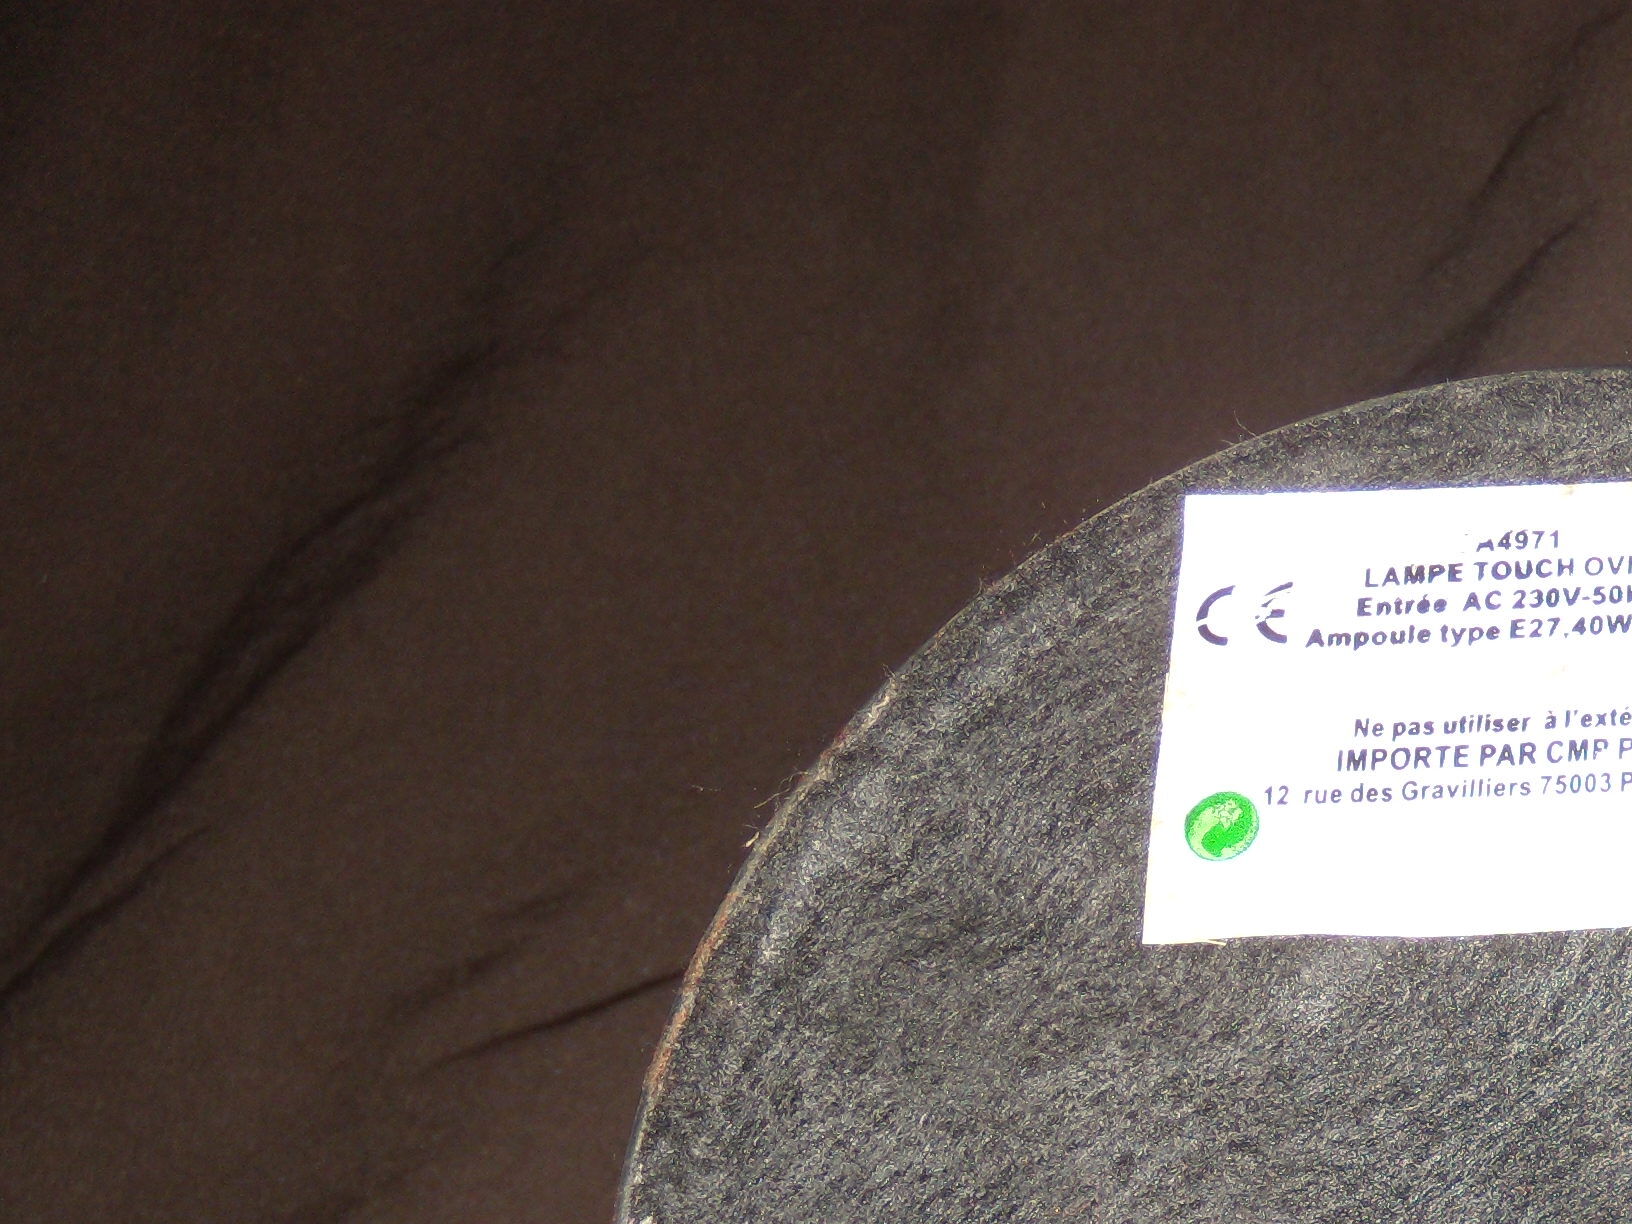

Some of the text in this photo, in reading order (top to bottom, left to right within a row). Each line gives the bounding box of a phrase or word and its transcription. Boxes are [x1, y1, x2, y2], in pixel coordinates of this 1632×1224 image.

[1364, 562, 1464, 588] LAMPE
[1473, 557, 1575, 582] TOUCH
[1356, 593, 1448, 617] Entrée
[1462, 590, 1502, 612] AC
[1304, 624, 1432, 652] Ampoule
[1439, 624, 1501, 648] type
[1354, 717, 1385, 738] Ne
[1391, 720, 1435, 742] pas
[1443, 713, 1531, 735] utiliser
[1544, 710, 1557, 730] à
[1337, 744, 1470, 772] IMPORTE
[1479, 741, 1537, 767] PAR
[1546, 738, 1609, 764] CMP
[1264, 784, 1289, 806] 12
[1303, 788, 1343, 805] rue
[1350, 782, 1393, 803] des
[1401, 778, 1532, 801] Gravilliers
[1540, 772, 1612, 795] 75003
